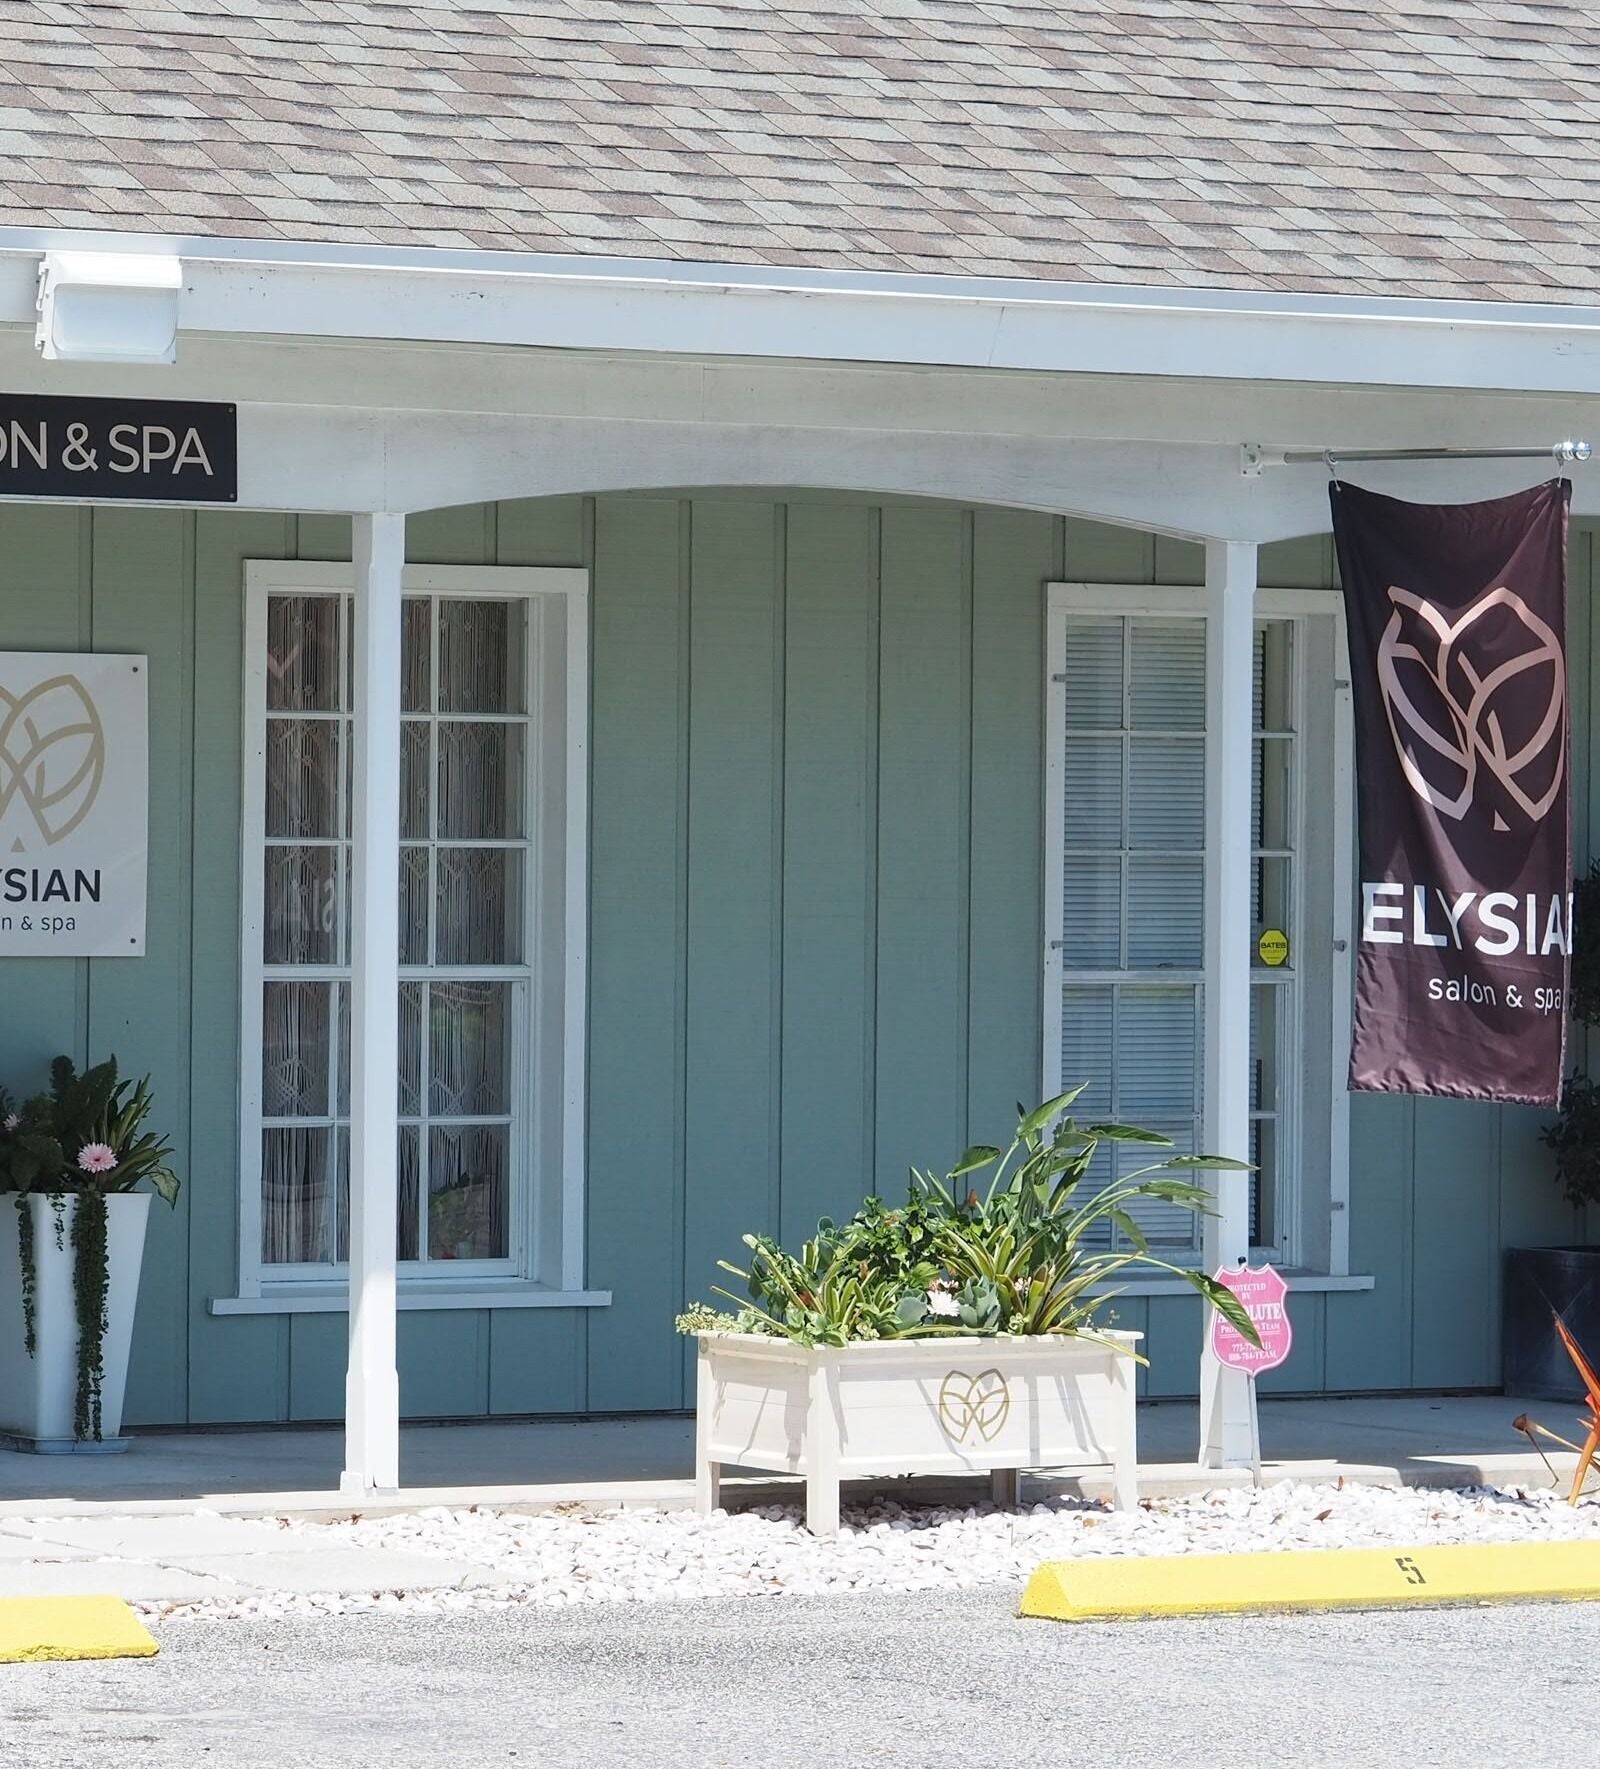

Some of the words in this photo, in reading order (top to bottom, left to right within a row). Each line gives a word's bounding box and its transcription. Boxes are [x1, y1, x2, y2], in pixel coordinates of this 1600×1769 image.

[62, 422, 99, 473] &
[109, 423, 215, 476] SPA
[20, 915, 33, 931] &
[41, 915, 76, 935] spa
[1428, 974, 1497, 1007] salon
[1505, 984, 1524, 1009] &
[1534, 985, 1562, 1016] spa
[1242, 1292, 1251, 1300] BY
[1394, 1557, 1426, 1584] 5
